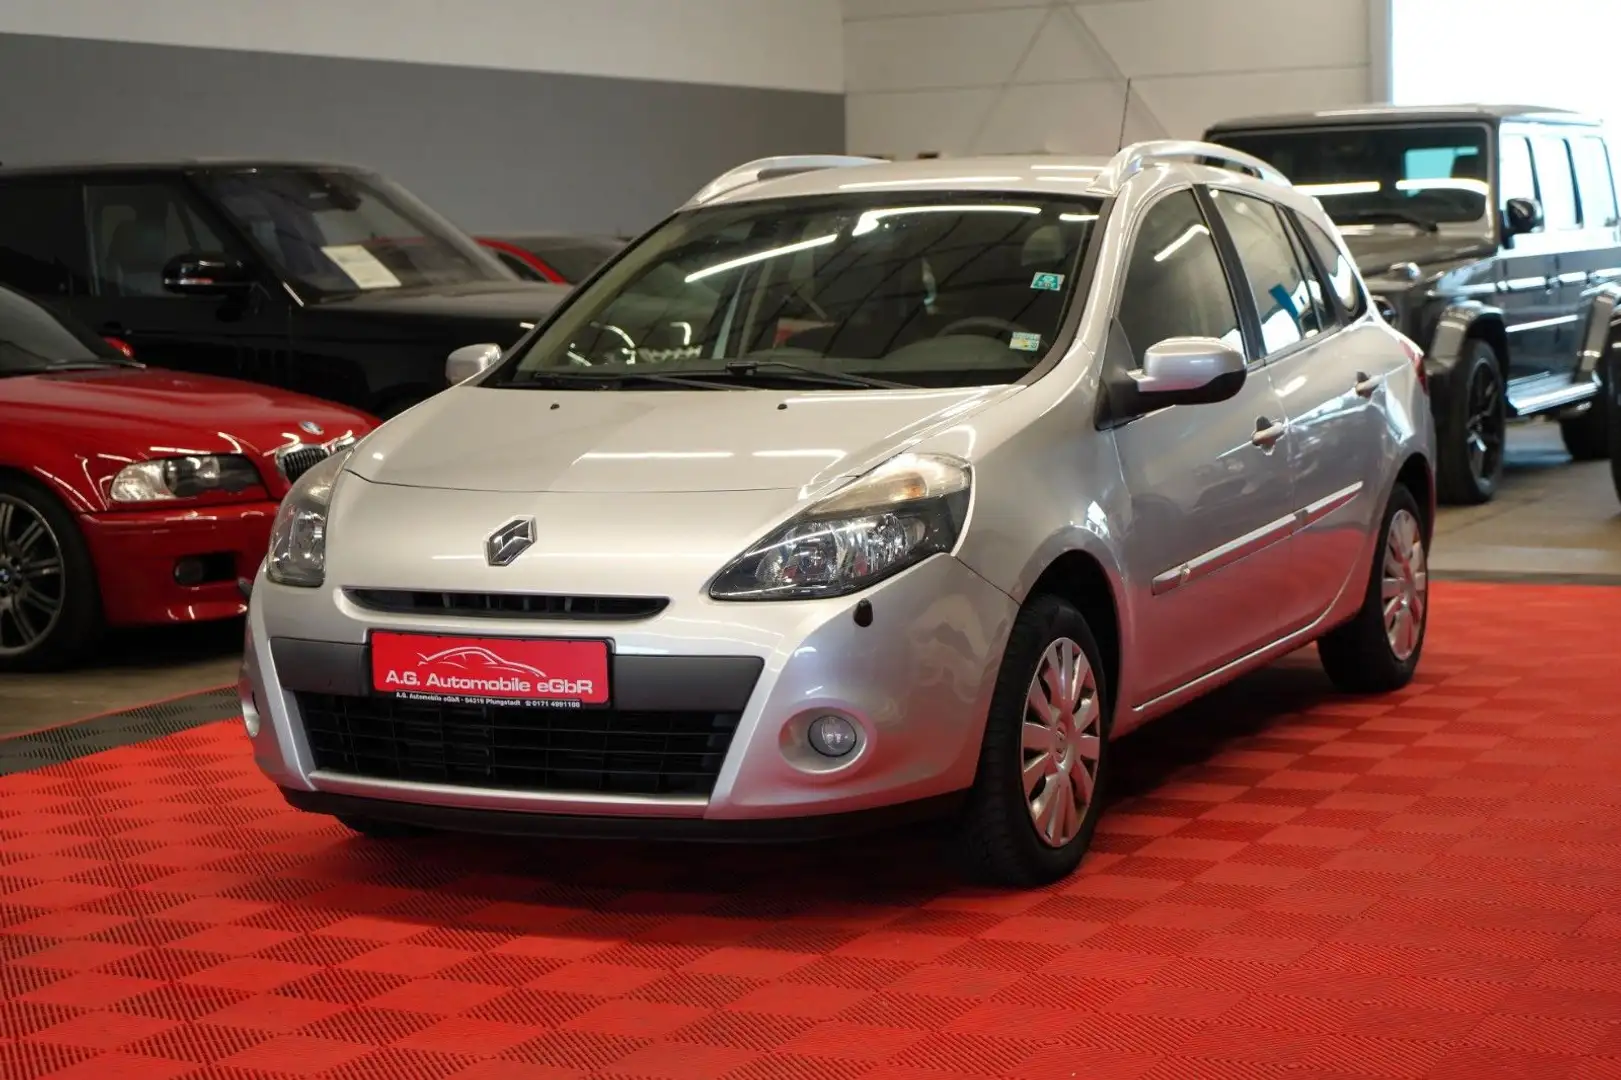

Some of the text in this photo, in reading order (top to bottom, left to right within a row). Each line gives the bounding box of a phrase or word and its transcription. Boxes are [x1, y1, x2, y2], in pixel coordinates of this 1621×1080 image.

[385, 669, 593, 695] A.G. Automobile eGbR
[409, 693, 442, 702] Automobile
